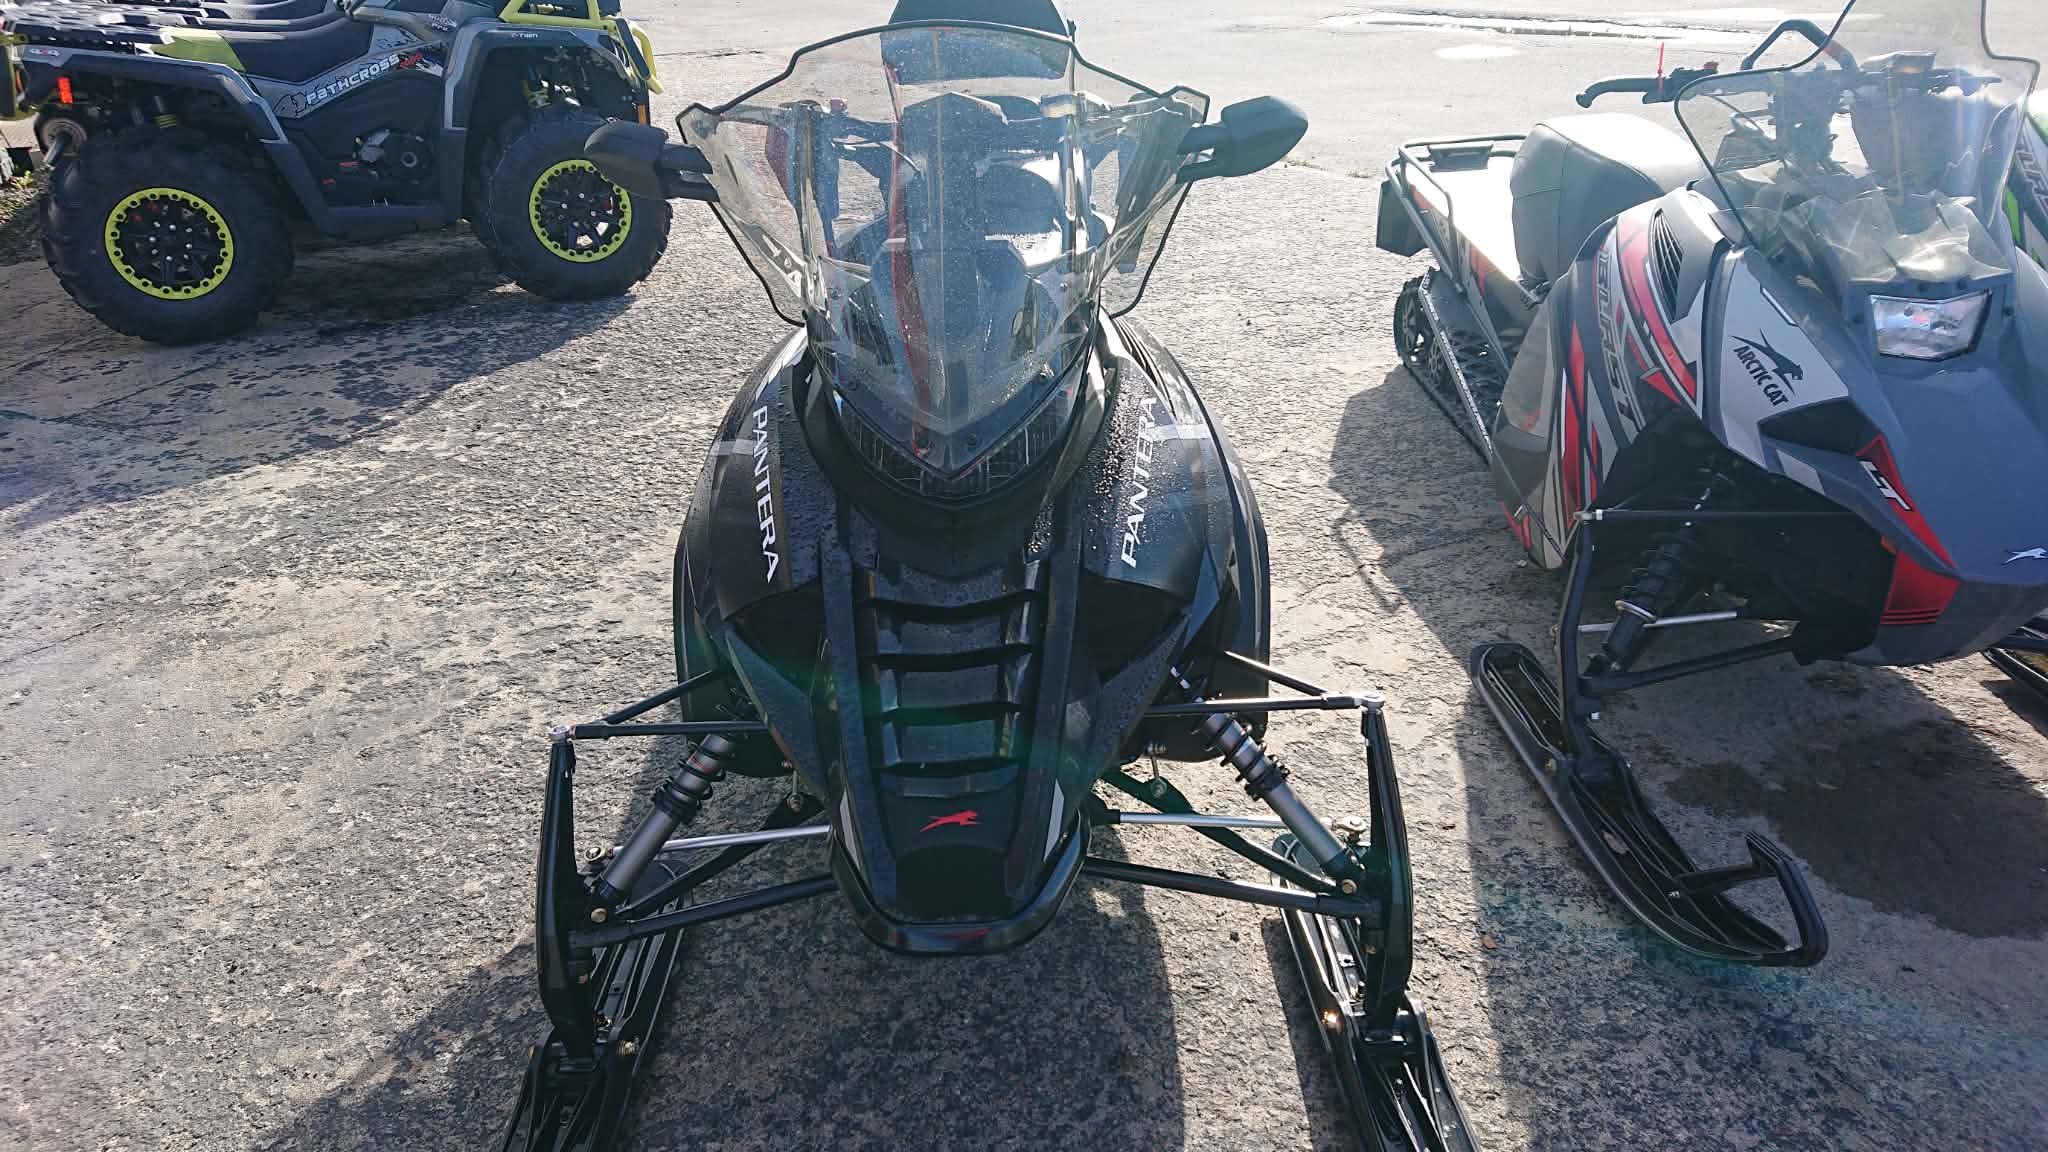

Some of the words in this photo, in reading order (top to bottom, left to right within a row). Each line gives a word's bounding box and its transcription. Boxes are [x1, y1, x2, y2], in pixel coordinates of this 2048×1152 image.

[1733, 345, 1769, 385] ARCTIC
[1763, 383, 1789, 406] CAT
[753, 405, 779, 583] PANTERA
[1121, 398, 1157, 568] PANTERA
